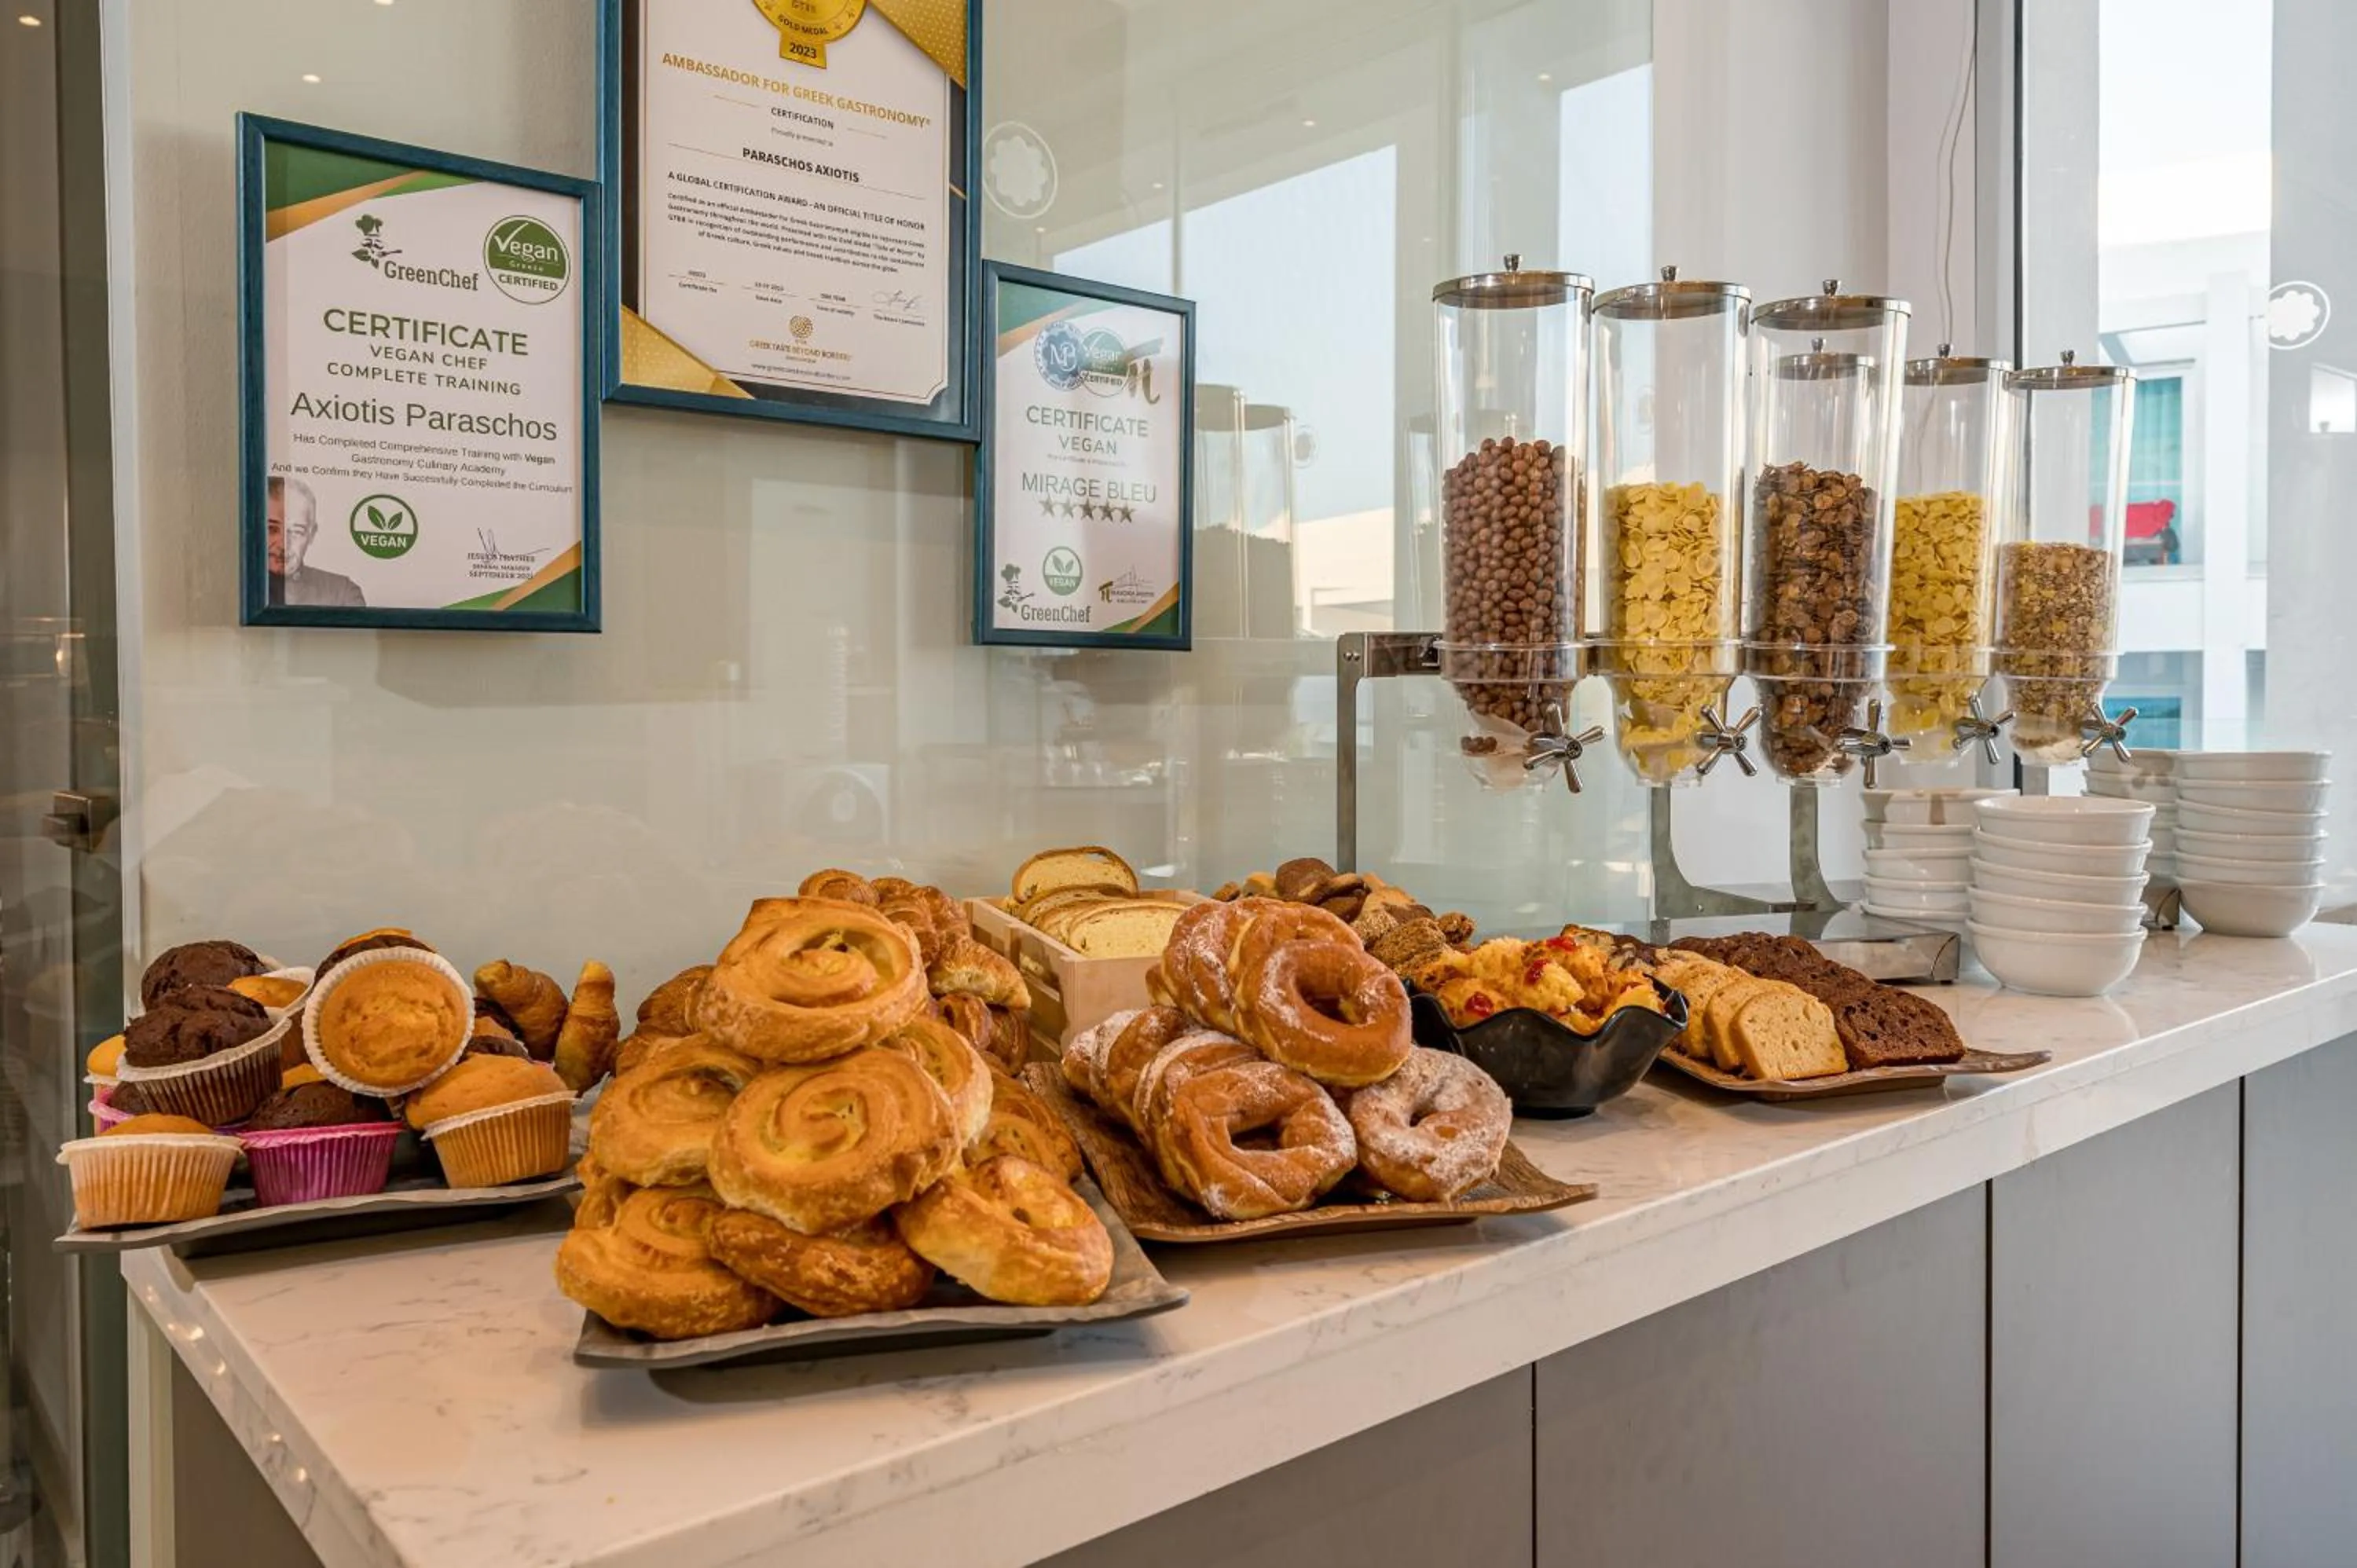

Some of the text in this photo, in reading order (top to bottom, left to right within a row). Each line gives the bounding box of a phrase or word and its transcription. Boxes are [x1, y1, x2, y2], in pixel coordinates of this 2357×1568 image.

[778, 13, 799, 31] GOLD
[790, 42, 818, 59] 2023
[662, 52, 761, 89] AMBASSADOR
[762, 78, 790, 94] FOR
[792, 86, 834, 108] GREEK
[770, 106, 834, 130] CERTIFICATION
[742, 147, 860, 183] PARASCHOS AXIOTIS
[668, 171, 675, 180] A
[676, 173, 712, 188] GLOBAL
[713, 180, 776, 200] CERTIFICATION
[827, 205, 860, 219] OFFICIAL
[494, 222, 559, 262] Vegan
[383, 261, 478, 291] GreenChef
[498, 273, 559, 291] CERTIFIED
[323, 308, 529, 356] CERTIFICATE
[370, 344, 488, 370] VEGAN CHEF
[327, 361, 522, 395] COMPLETE TRAINING
[290, 391, 557, 441] Axiotis Paraschos
[1025, 405, 1149, 445] CERTIFICATE
[292, 433, 316, 444] Has
[318, 434, 376, 450] Completed
[379, 440, 459, 456] Comprehensive
[461, 447, 501, 462] Training
[524, 453, 556, 467] Vegan
[1058, 434, 1117, 455] VEGAN
[271, 462, 292, 472] And
[350, 452, 507, 477] Gastronomy Culinary Academy
[1021, 471, 1157, 504] MIRAGE BLEU
[360, 534, 407, 548] VEGAN
[1050, 577, 1076, 587] VEGAN
[1021, 603, 1091, 623] GreenChef
